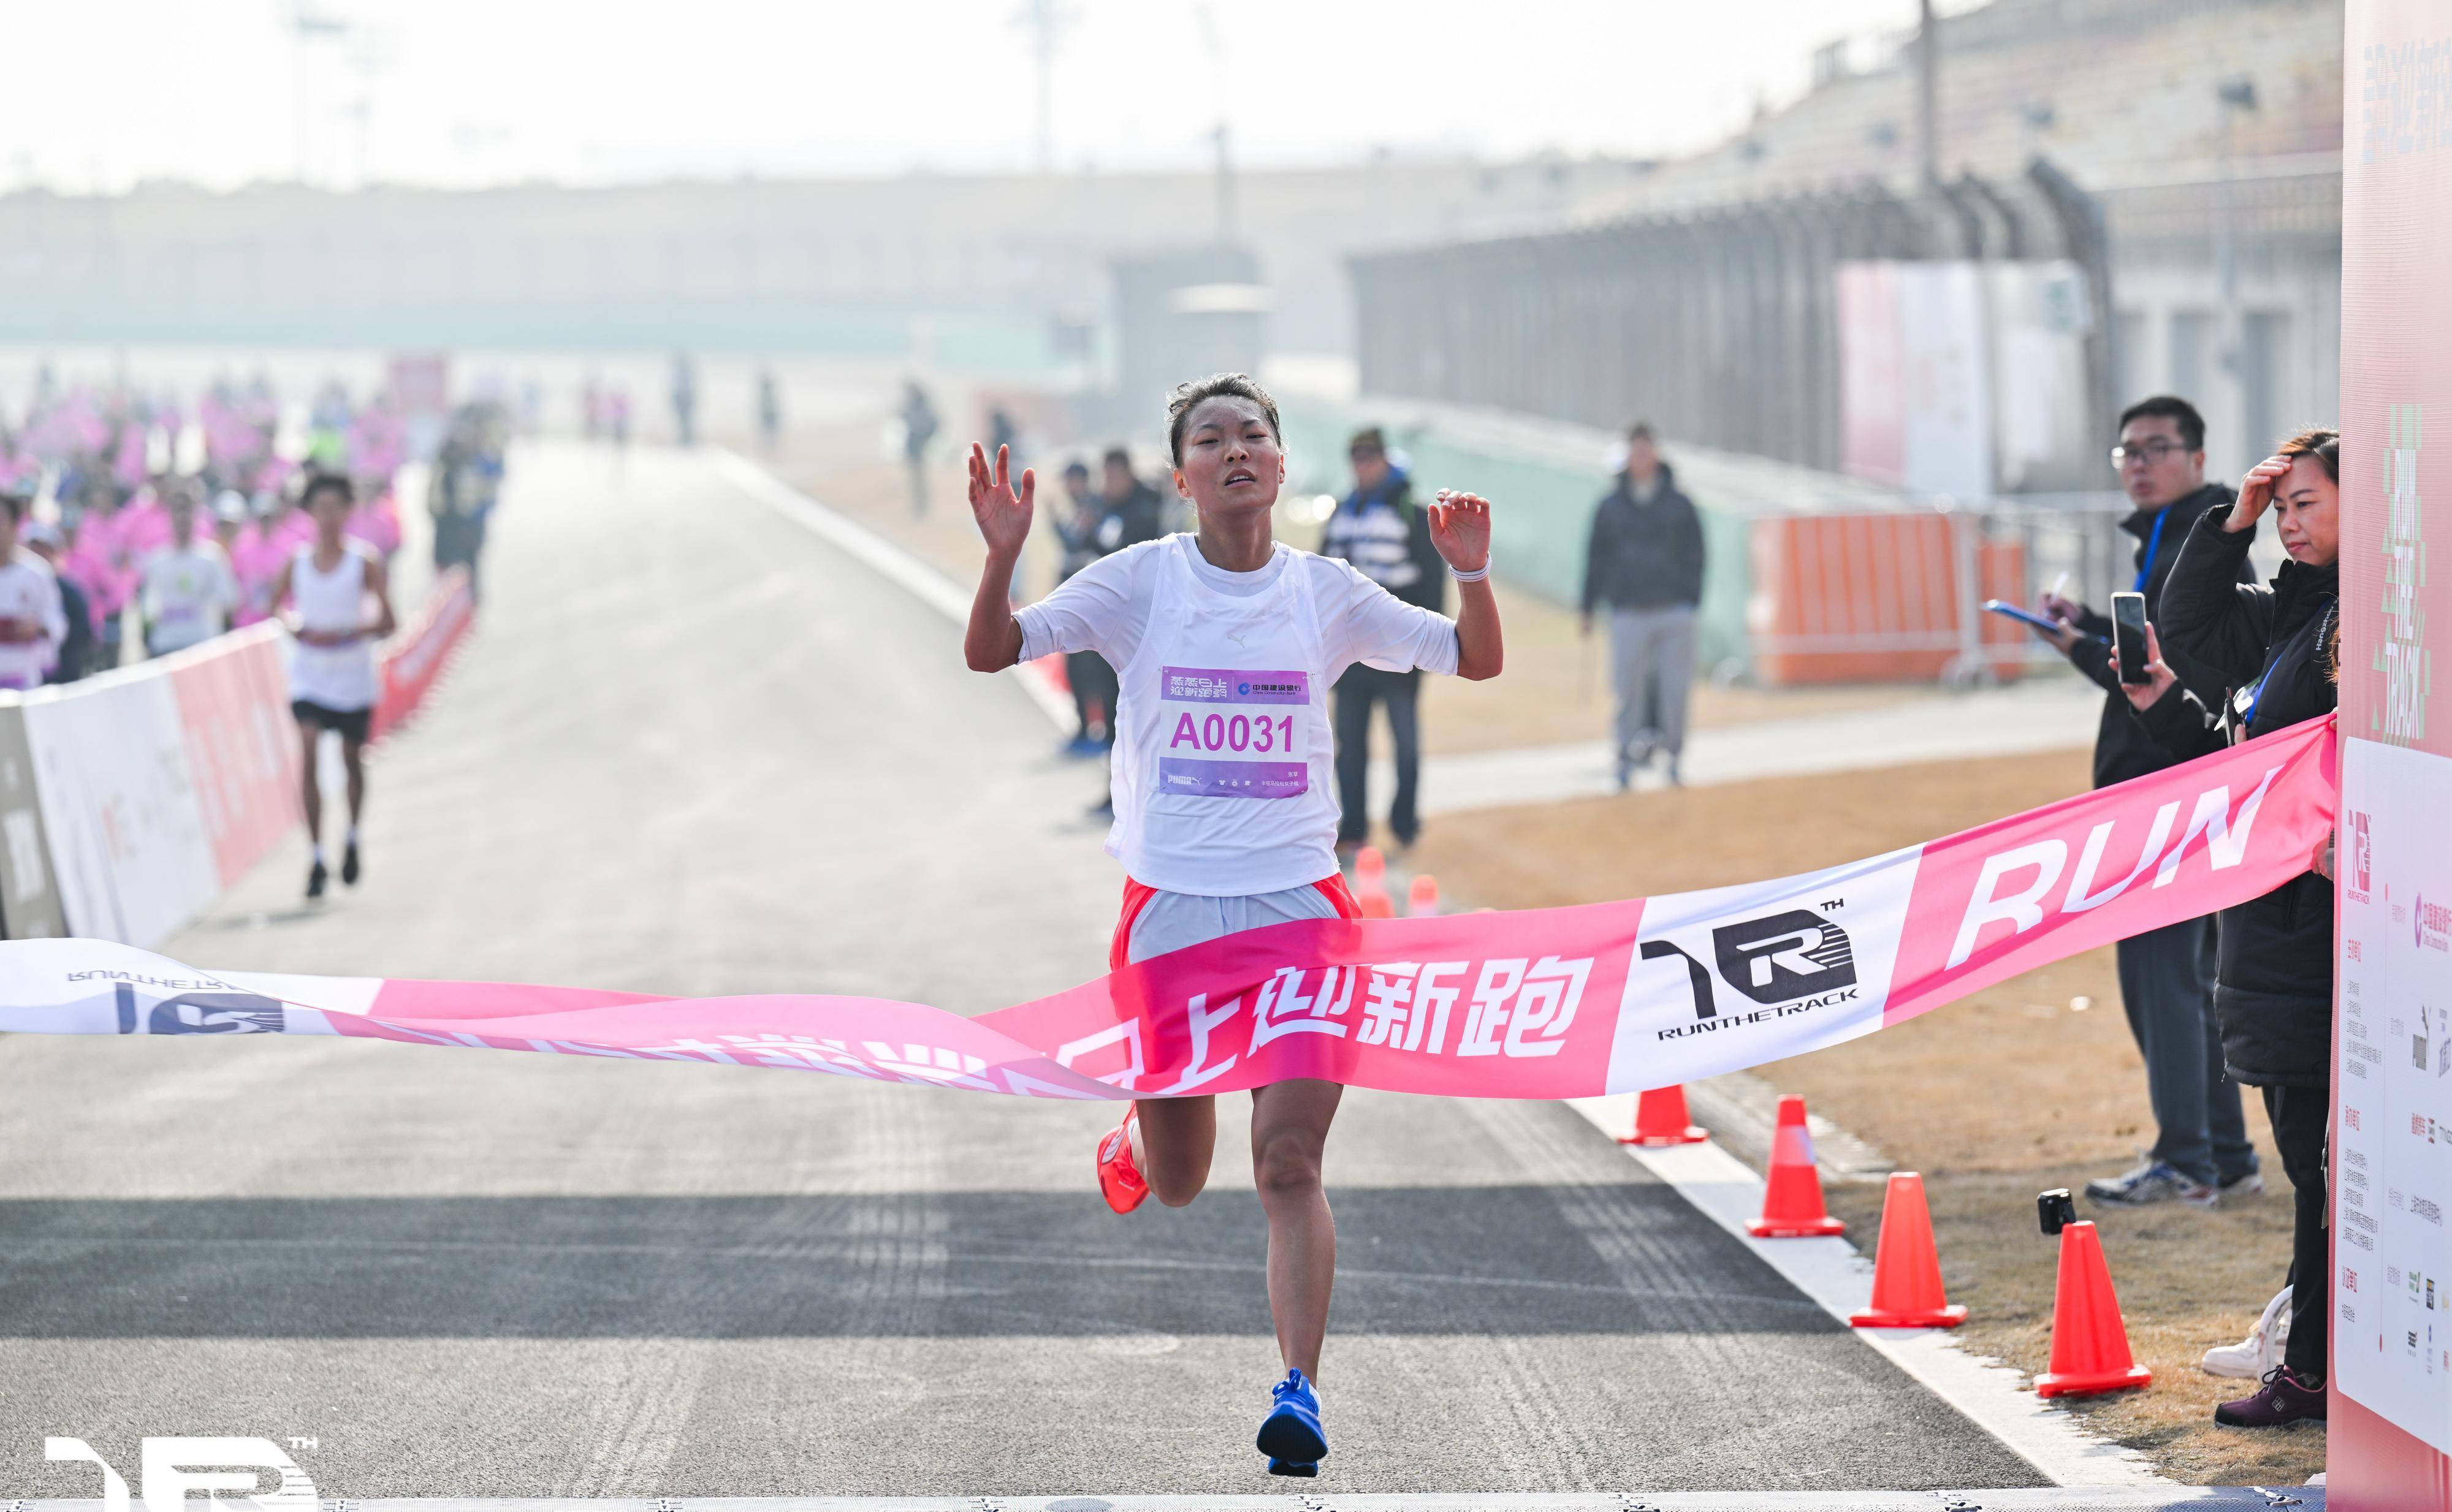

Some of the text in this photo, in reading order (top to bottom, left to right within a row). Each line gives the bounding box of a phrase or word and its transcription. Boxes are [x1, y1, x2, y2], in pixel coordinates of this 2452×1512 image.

[2394, 448, 2416, 541] RUN
[2394, 545, 2413, 639] THE
[2316, 606, 2334, 651] Hangzhou
[2385, 642, 2421, 740] TRACK
[1170, 712, 1293, 753] A0031
[1167, 774, 1192, 785] PUMA
[1944, 762, 2286, 971] RUN
[1821, 898, 1845, 911] TH
[1658, 988, 1860, 1041] RUNTHETRACK
